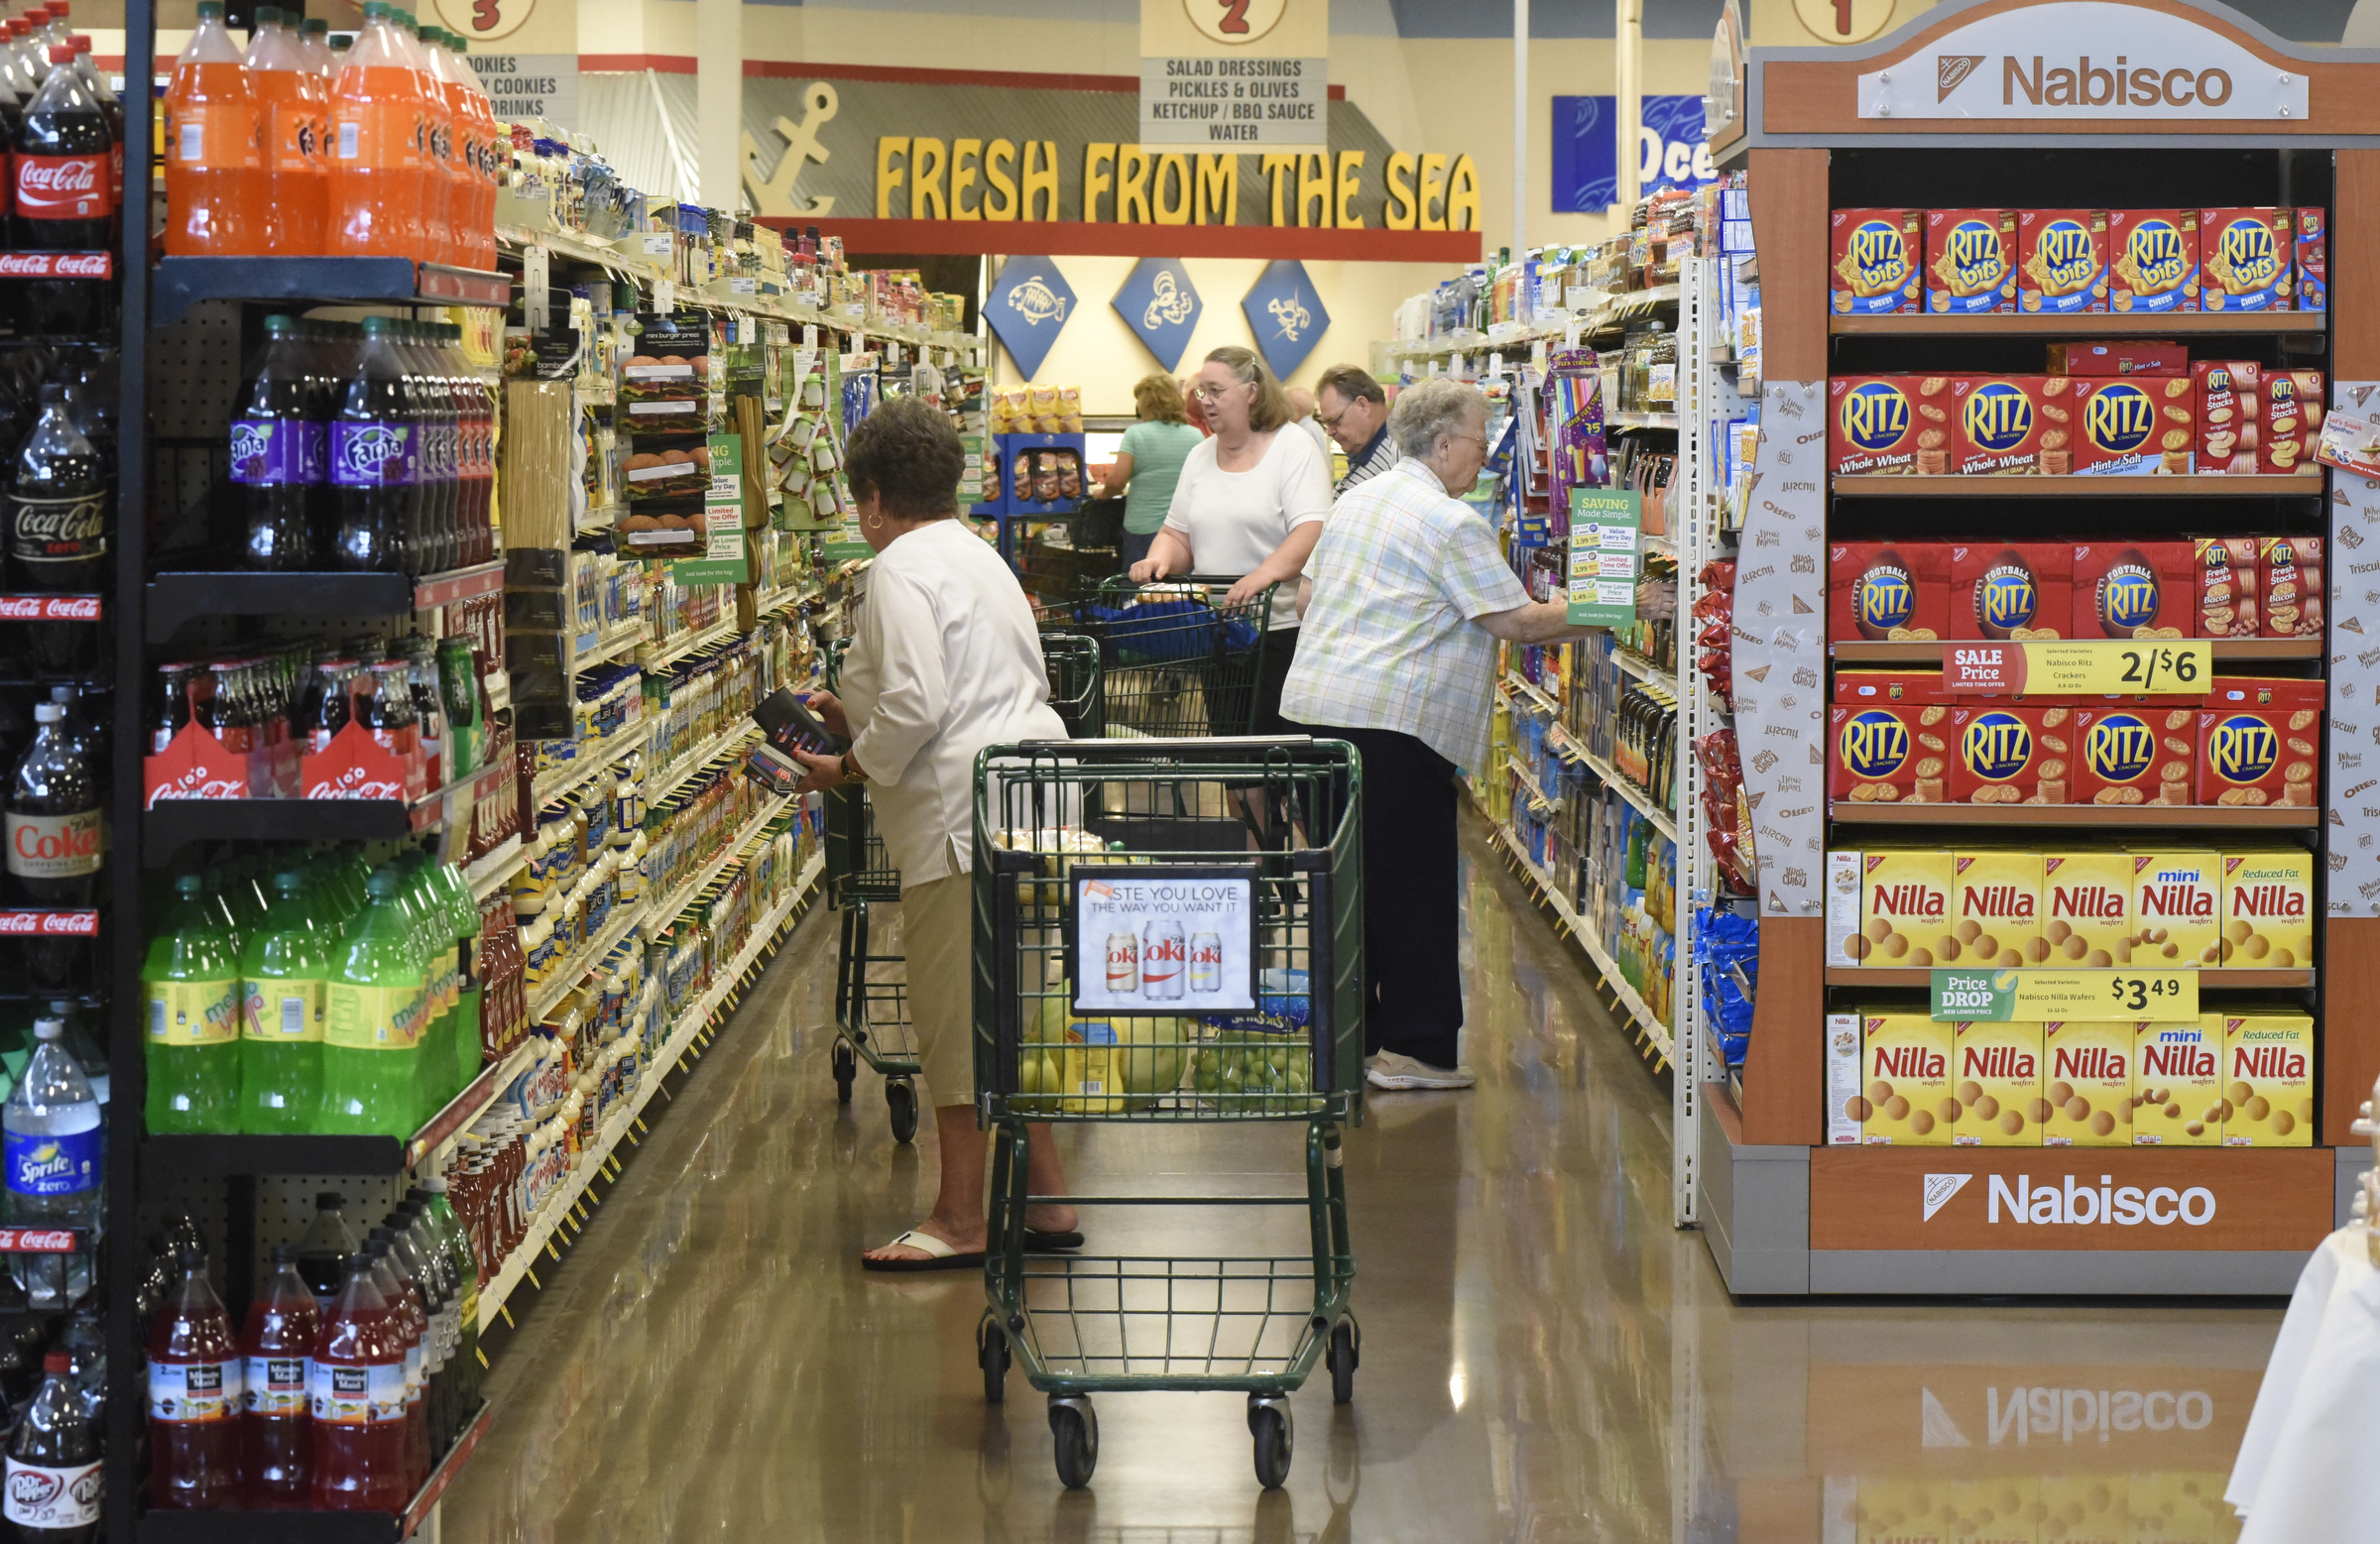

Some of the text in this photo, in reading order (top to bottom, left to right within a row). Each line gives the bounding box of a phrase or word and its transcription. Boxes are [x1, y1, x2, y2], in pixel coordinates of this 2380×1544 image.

[472, 0, 500, 31] 3
[1219, 0, 1250, 34] 2
[1834, 0, 1852, 36] 1
[1167, 60, 1301, 76] SALAD DRESSINGS
[1943, 60, 1967, 85] NABISCO
[494, 78, 556, 93] COOKIES
[1170, 82, 1299, 97] PICKLES & OLIVES
[2002, 56, 2232, 107] Nabisco
[491, 100, 543, 115] DRINKS
[1153, 103, 1315, 119] KETCHUP BBQ SAUCE
[1210, 125, 1258, 140] WATER
[20, 161, 97, 190] Coca-Cola
[877, 136, 1482, 232] FRESH FROM THE SEA
[1852, 230, 1900, 269] RITZ
[1950, 230, 1996, 269] RITZ
[2041, 229, 2087, 268] RITZ
[2132, 228, 2179, 267] RITZ
[2223, 228, 2271, 266] RITZ
[1863, 261, 1903, 287] bits
[2051, 260, 2089, 285] bits
[2234, 258, 2273, 284] bits
[1869, 297, 1894, 308] CHEESE
[2058, 296, 2082, 307] CHEESE
[2208, 372, 2231, 390] RITZ
[2272, 381, 2294, 399] RITZ
[2207, 398, 2233, 410] Stacks
[2208, 391, 2231, 402] Fresh
[1585, 422, 1601, 434] 75
[1845, 393, 1905, 441] RITZ
[1968, 394, 2028, 442] RITZ
[2089, 396, 2150, 442] RITZ
[347, 436, 405, 470] Fanta
[1840, 457, 1873, 474] Whole
[1876, 453, 1911, 467] Wheat
[2091, 460, 2112, 474] Hint
[2122, 453, 2142, 466] Salt
[1582, 498, 1628, 510] SAVING
[1603, 510, 1632, 520] Simple.
[16, 502, 103, 540] Coca-Cola
[2205, 547, 2228, 565] RITZ
[2271, 546, 2294, 564] RITZ
[1863, 565, 1908, 581] FOOTBALL
[1985, 565, 2029, 581] FOOTBALL
[2106, 564, 2152, 581] FOOTBALL
[2205, 573, 2232, 586] Stacks
[2206, 566, 2229, 578] Fresh
[1863, 584, 1910, 621] RITZ
[1985, 585, 2032, 621] RITZ
[2107, 583, 2153, 621] RITZ
[2203, 593, 2230, 604] Bacon
[2269, 592, 2296, 602] Bacon
[1956, 650, 2002, 665] SALE
[1962, 666, 1999, 679] Price
[1844, 721, 1905, 770] RITZ
[1967, 724, 2027, 771] RITZ
[2089, 725, 2150, 773] RITZ
[2213, 726, 2274, 773] RITZ
[2344, 779, 2377, 798] OREO
[16, 825, 99, 859] Coke
[2158, 869, 2201, 882] mini
[2242, 869, 2299, 879] Reduced Fat
[1109, 888, 1237, 900] STE YOU LOVE
[1872, 885, 1945, 916] Nilla
[1963, 886, 2034, 916] Nilla
[2053, 887, 2124, 917] Nilla
[2142, 886, 2213, 916] Nilla
[2233, 886, 2305, 916] Nilla
[1091, 902, 1237, 912] THE WAY YOU WANT IT
[1948, 977, 1987, 991] Price
[1942, 992, 1993, 1008] DROP
[1874, 1046, 1946, 1078] Nilla
[1964, 1046, 2035, 1078] Nilla
[2055, 1047, 2126, 1079] Nilla
[2144, 1045, 2215, 1076] Nilla
[2233, 1046, 2306, 1078] Nilla
[21, 1156, 68, 1183] Sprite
[38, 1180, 70, 1192] zero
[1929, 1179, 1954, 1203] NABISCO
[1988, 1175, 2216, 1227] Nabisco
[189, 1369, 220, 1380] Minute
